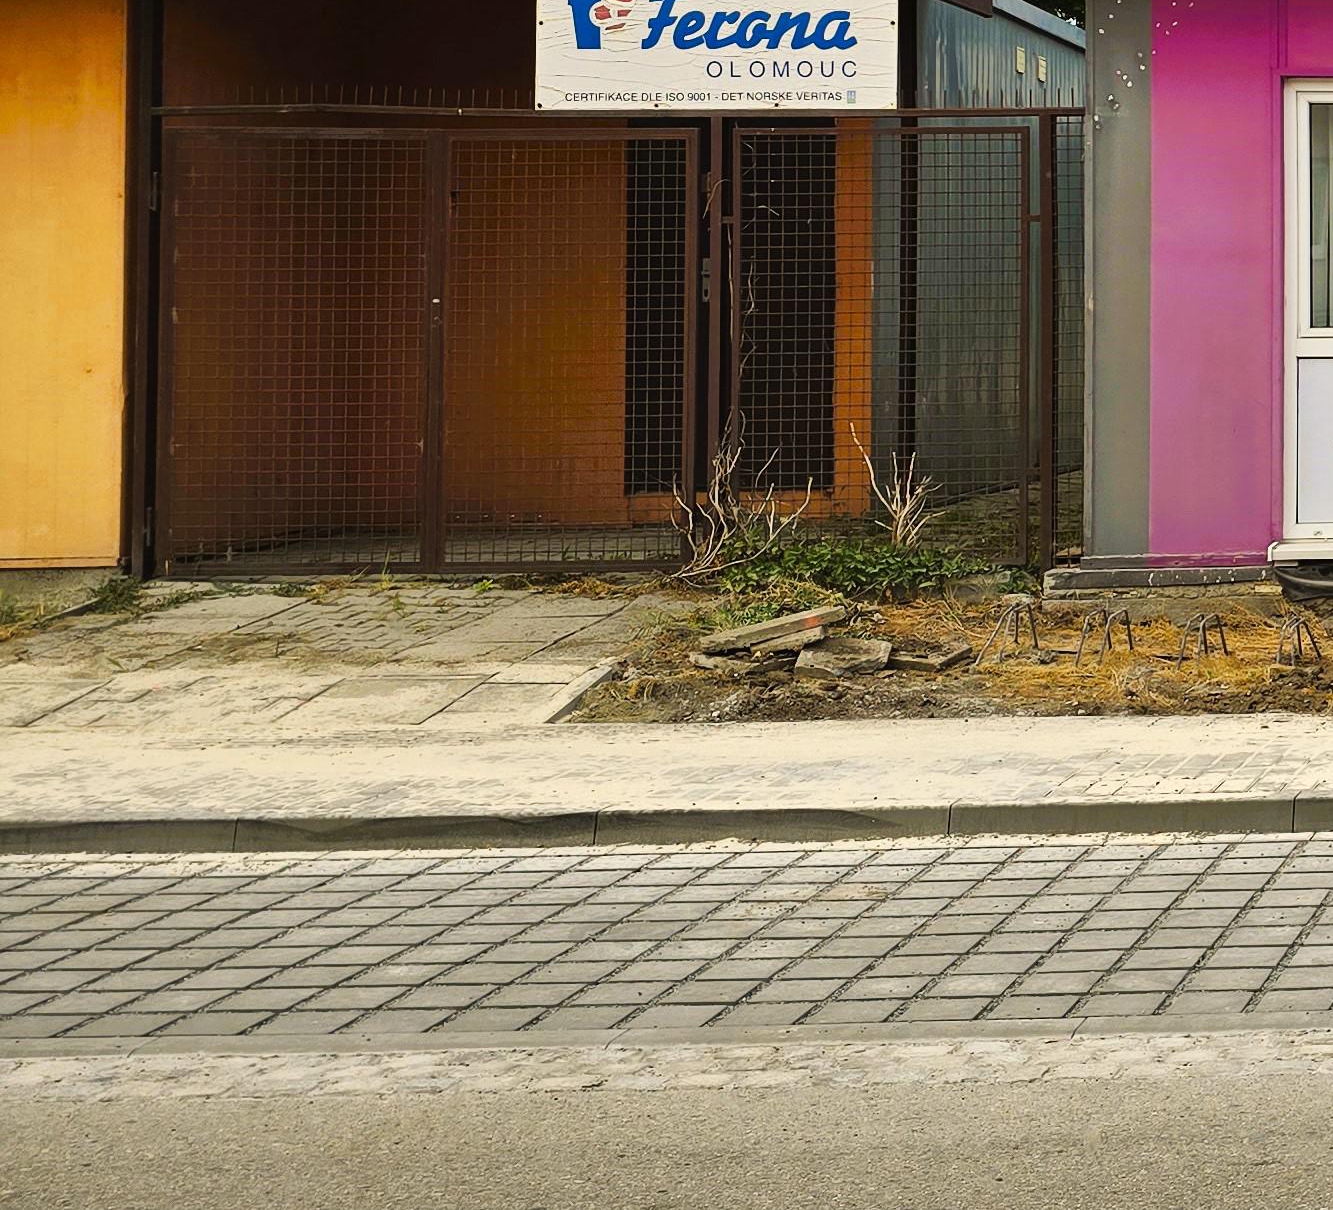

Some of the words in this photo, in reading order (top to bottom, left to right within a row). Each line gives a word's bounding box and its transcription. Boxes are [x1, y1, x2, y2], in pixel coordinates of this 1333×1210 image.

[707, 60, 857, 78] OLOMOUC
[565, 92, 638, 102] CERTIFIKACE
[641, 92, 663, 101] DLE
[666, 92, 685, 101] ISO
[687, 92, 711, 101] 9001
[721, 92, 743, 101] DET
[746, 92, 793, 101] NORSKE
[796, 92, 842, 101] VERITAS
